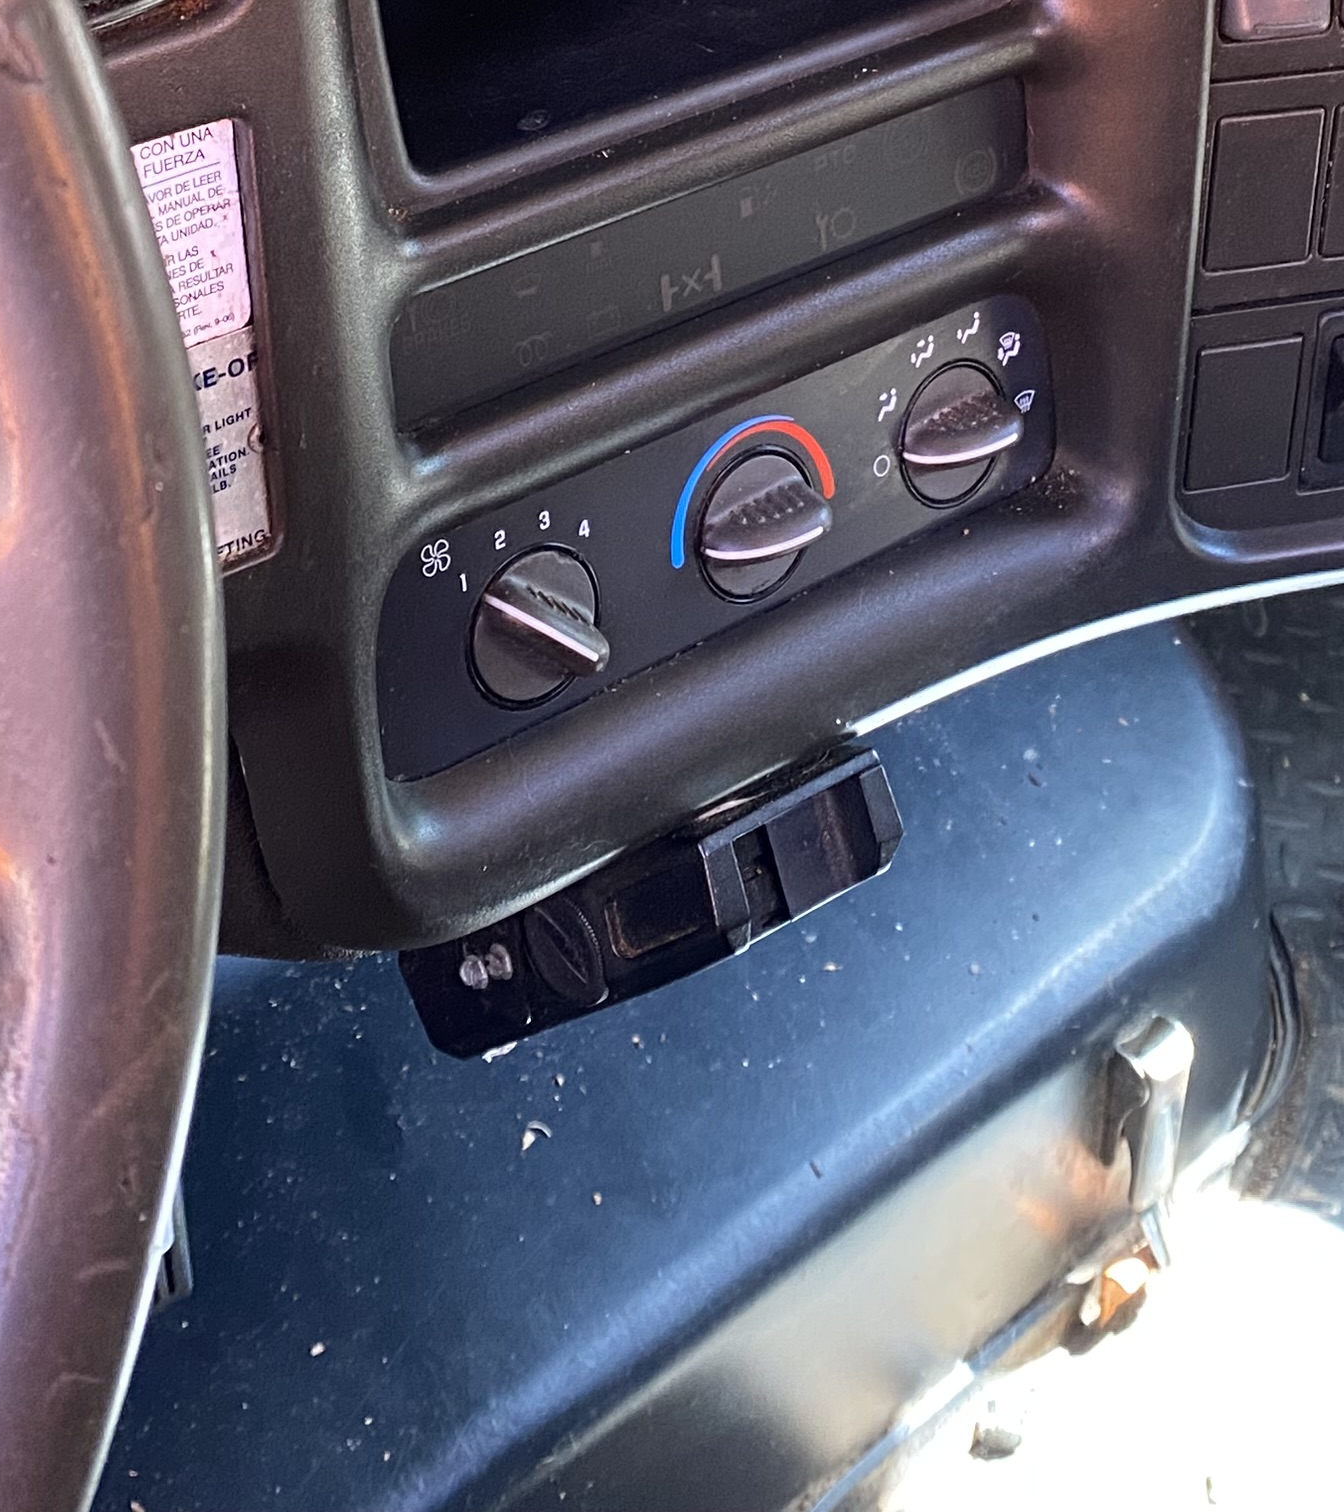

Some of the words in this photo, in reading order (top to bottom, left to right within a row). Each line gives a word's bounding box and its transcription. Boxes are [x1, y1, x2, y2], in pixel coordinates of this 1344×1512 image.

[140, 136, 174, 160] CON
[179, 126, 214, 148] UNA
[143, 148, 205, 178] FUERZA
[146, 187, 173, 205] VOR
[175, 180, 191, 196] DE
[193, 170, 223, 188] LEER
[158, 192, 206, 216] MANUAL
[208, 184, 224, 199] DE
[166, 214, 182, 229] DE
[184, 198, 231, 222] OPERAR
[178, 245, 200, 262] LAS
[190, 258, 205, 273] DE
[178, 263, 234, 292] RESULTAR
[214, 407, 252, 432] LIGHT
[210, 464, 237, 482] AILS
[458, 572, 468, 592] 1
[493, 530, 507, 550] 2
[538, 510, 550, 530] 3
[578, 519, 590, 539] 4
